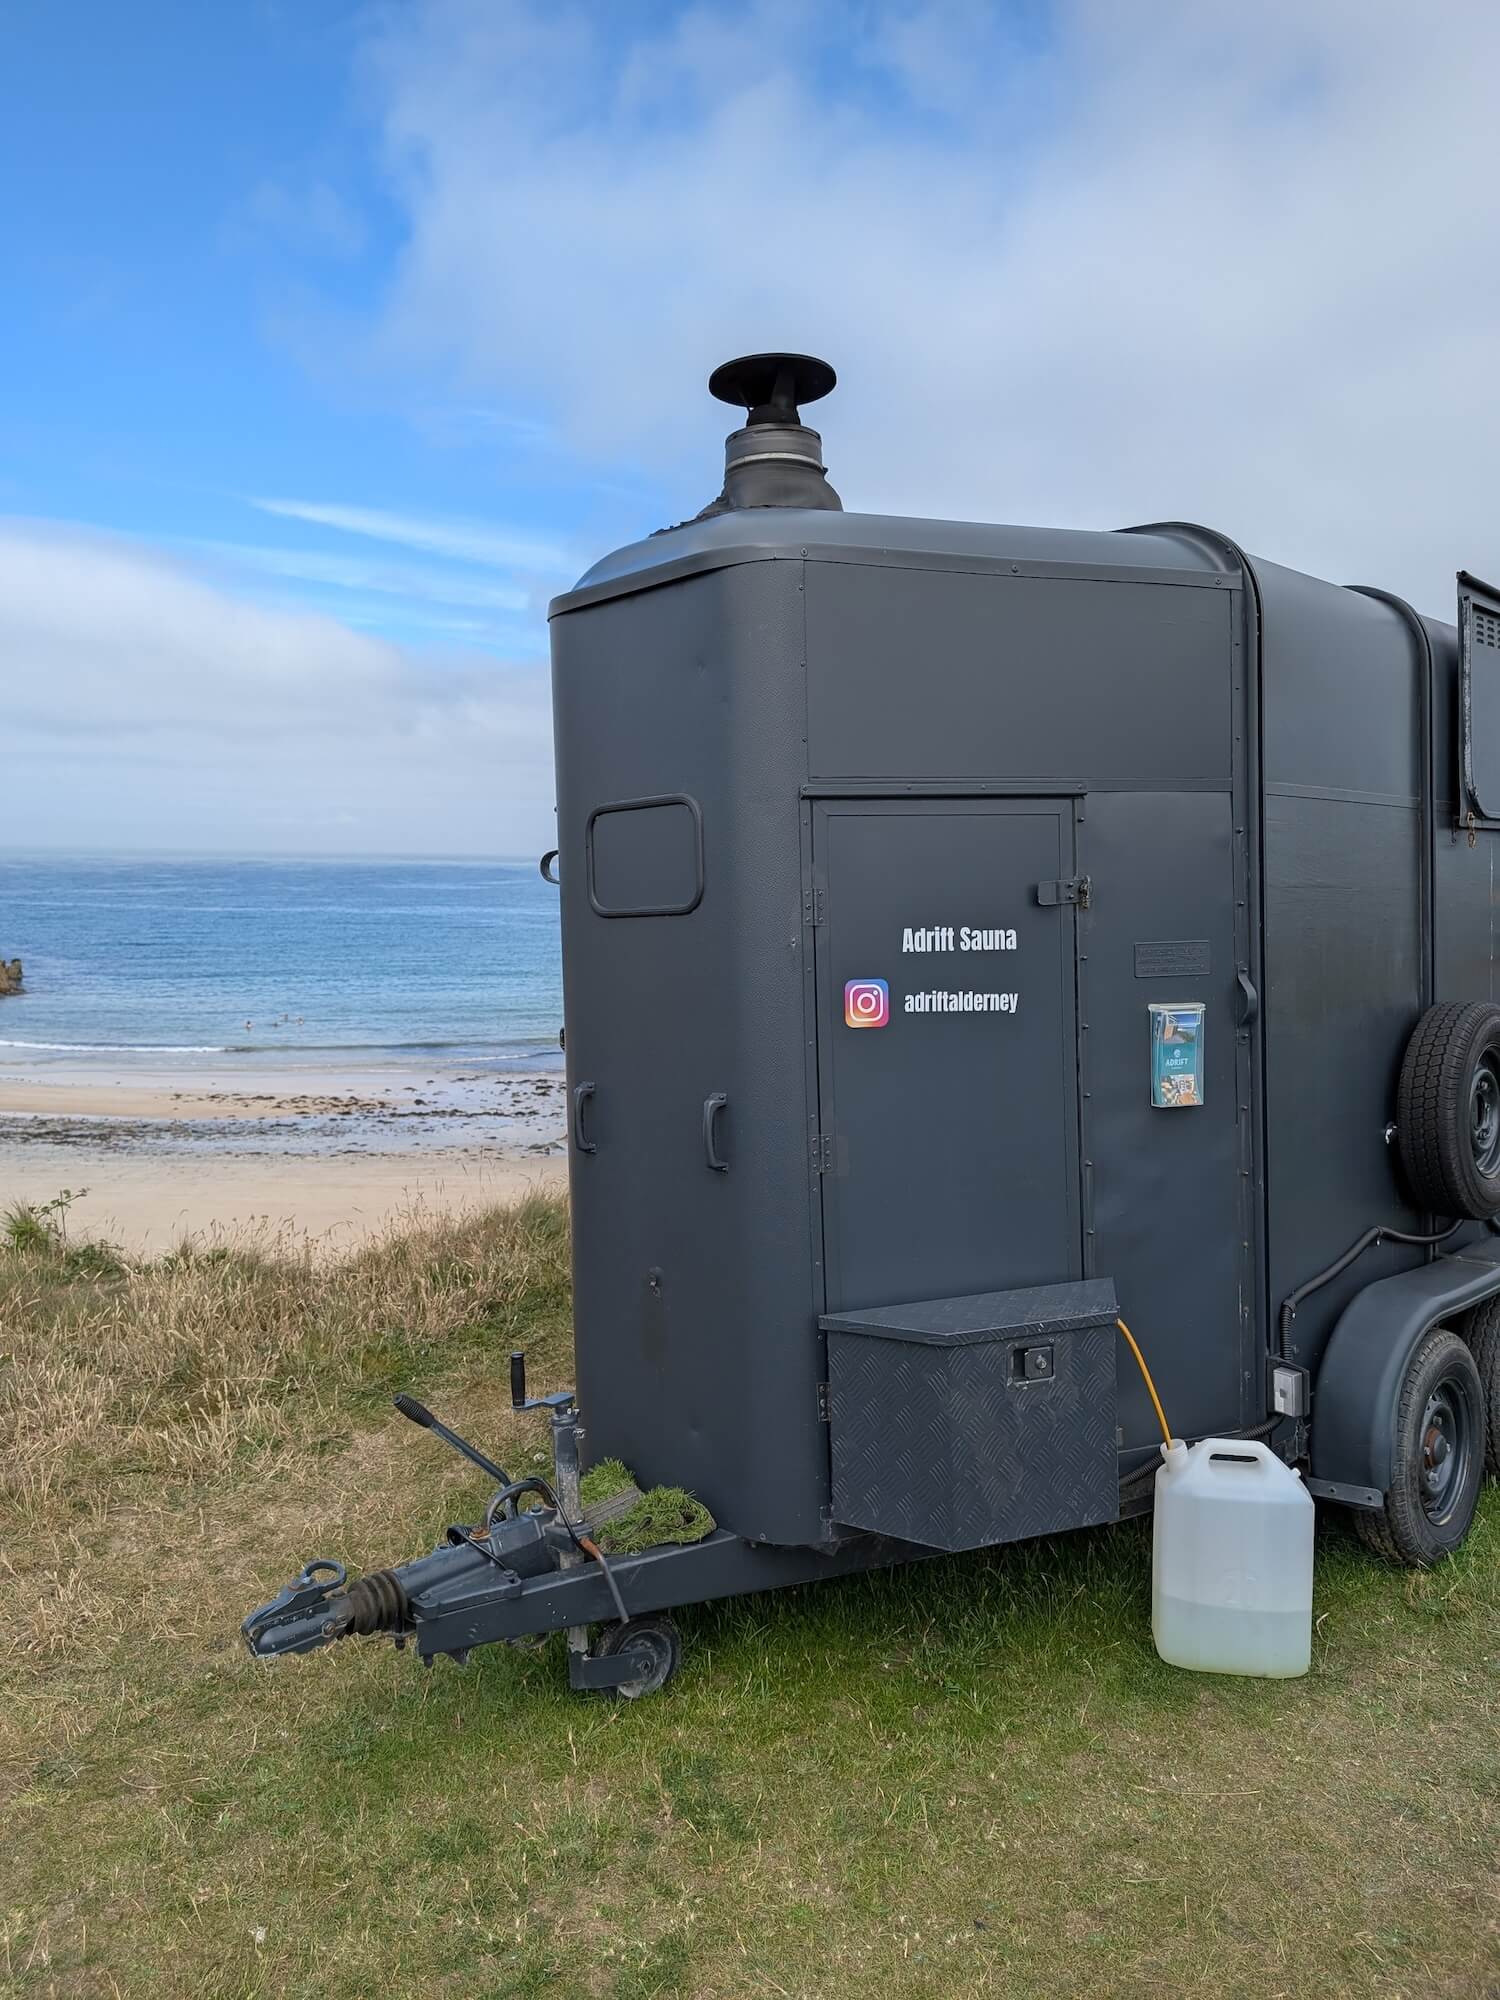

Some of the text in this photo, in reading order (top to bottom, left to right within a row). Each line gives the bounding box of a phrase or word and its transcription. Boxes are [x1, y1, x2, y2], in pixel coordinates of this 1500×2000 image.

[902, 926, 1017, 952] Adrift Sauna
[904, 990, 1019, 1014] adriftalderney
[1165, 1057, 1189, 1067] ADRIFT
